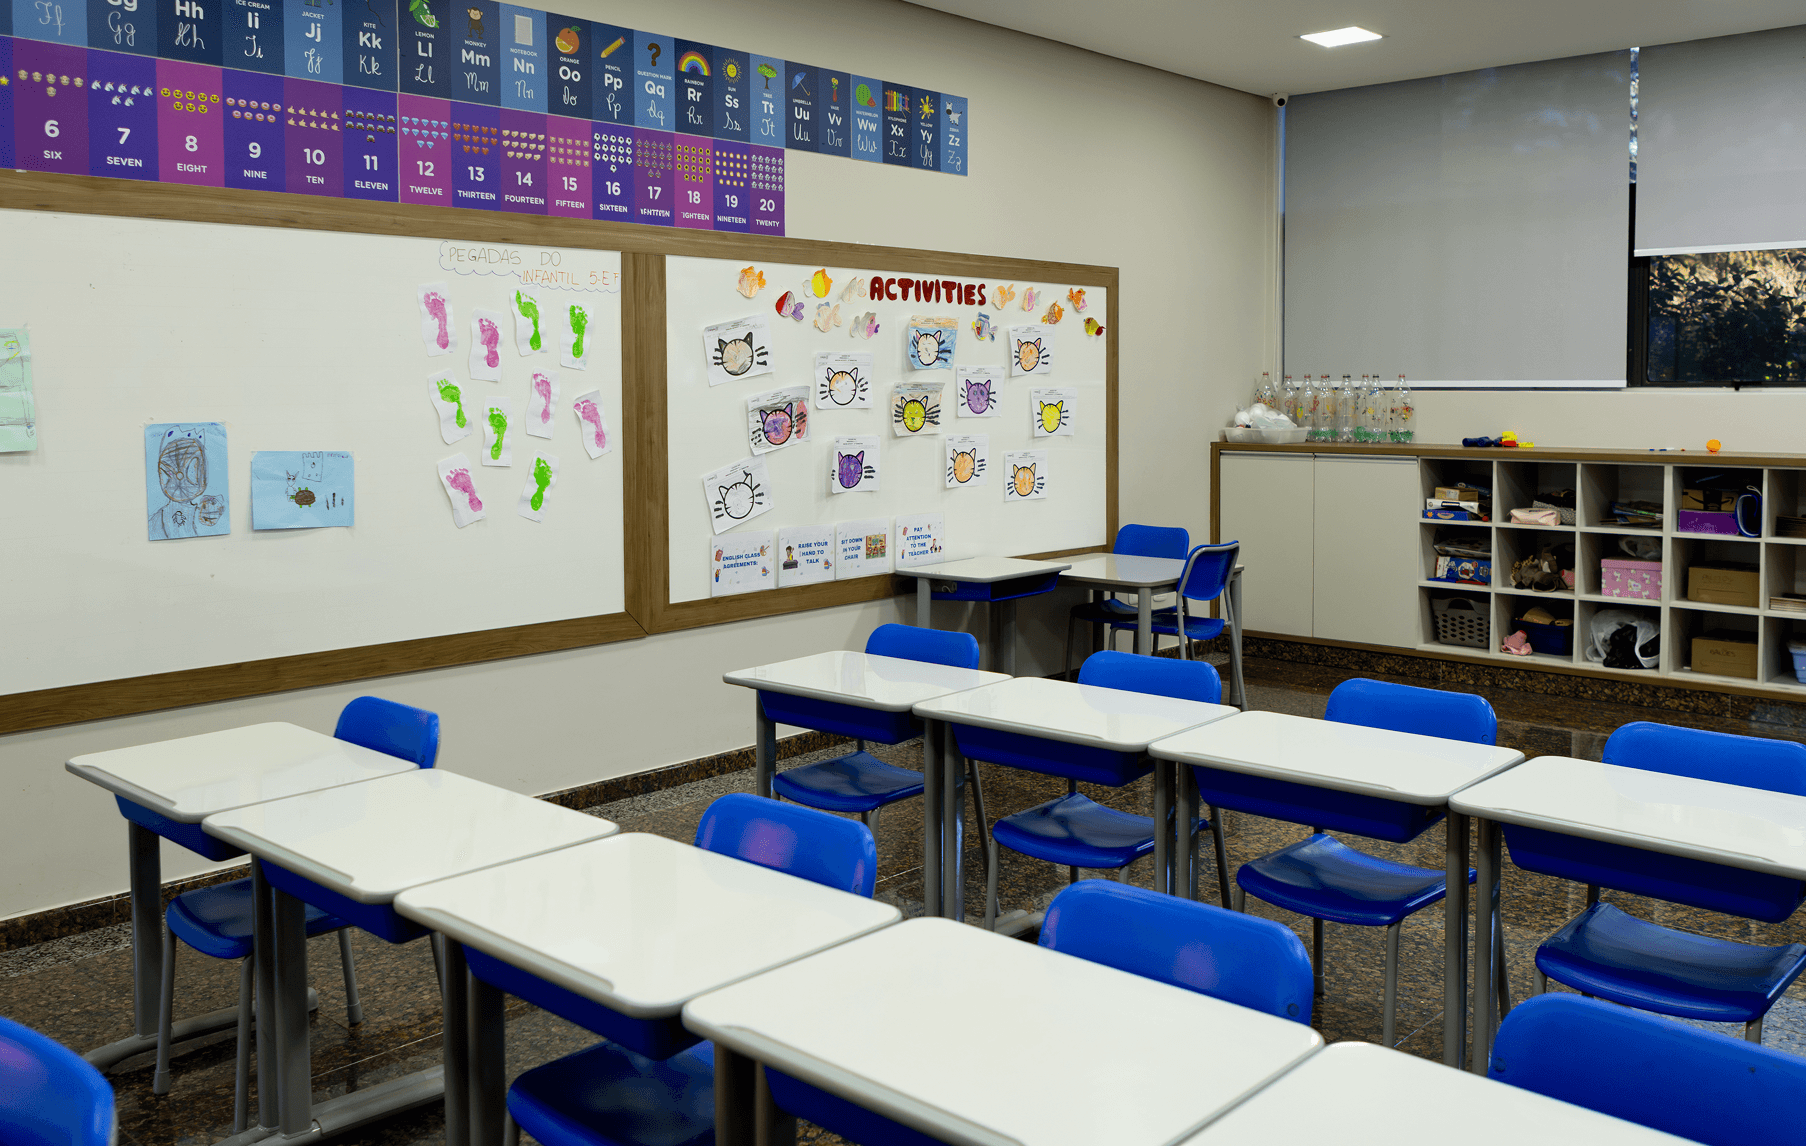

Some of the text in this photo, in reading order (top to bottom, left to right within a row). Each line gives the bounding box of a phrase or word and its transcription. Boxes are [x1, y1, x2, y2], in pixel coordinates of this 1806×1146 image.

[176, 0, 203, 19] Hh
[248, 1, 270, 10] CREAM
[302, 11, 324, 20] JACKET
[305, 23, 321, 42] Jj
[415, 31, 434, 39] LEMON
[359, 31, 382, 49] Kk
[464, 40, 486, 48] MONKEY
[462, 49, 490, 67] Mm
[510, 48, 538, 57] NOTEBOOK
[360, 55, 381, 75] Kk
[514, 58, 535, 74] Nn
[605, 64, 621, 72] PENCIL
[559, 66, 581, 82] Oo
[637, 70, 658, 79] QUESTION
[464, 72, 489, 93] Mm
[604, 73, 622, 90] Pp
[515, 80, 534, 99] Nn
[645, 81, 664, 98] Qq
[688, 88, 702, 102] Rr
[606, 93, 621, 119] Pp
[725, 95, 739, 109] Ss
[762, 101, 774, 115] Tt
[795, 107, 809, 120] Uu
[828, 112, 842, 126] Vv
[44, 120, 59, 137] 6
[858, 118, 877, 132] Ww
[891, 124, 904, 137] Xx
[117, 128, 130, 144] 7
[794, 123, 810, 142] Uu
[920, 129, 932, 144] Yy
[185, 135, 198, 152] 8
[949, 135, 960, 146] Zz
[44, 150, 62, 160] SIX
[248, 142, 261, 158] 9
[304, 148, 325, 165] 10
[107, 156, 142, 167] SEVEN
[177, 163, 207, 173] EIGHT
[363, 155, 378, 170] 11
[417, 161, 434, 176] 12
[244, 170, 267, 179] NINE
[306, 176, 324, 184] TEN
[468, 166, 485, 181] 13
[516, 171, 533, 186] 14
[355, 180, 388, 190] ELEVEN
[409, 186, 443, 195] TWELVE
[562, 177, 577, 191] 15
[606, 181, 621, 196] 16
[457, 190, 496, 200] THIRTEEN
[505, 195, 544, 205] FOURTEEN
[648, 186, 662, 200] 17
[687, 190, 700, 204] 18
[556, 200, 584, 208] FIFTEEN
[725, 194, 738, 208] 19
[760, 199, 775, 212] 20
[599, 204, 628, 213] SIXTEEN
[717, 215, 746, 224] NINETEEN
[756, 219, 779, 227] TWENTY
[450, 247, 561, 266] PEGADAS DO
[523, 269, 579, 285] INFANTIL
[870, 276, 986, 306] ACTIVITIES
[723, 561, 758, 570] AGREEMENTS:
